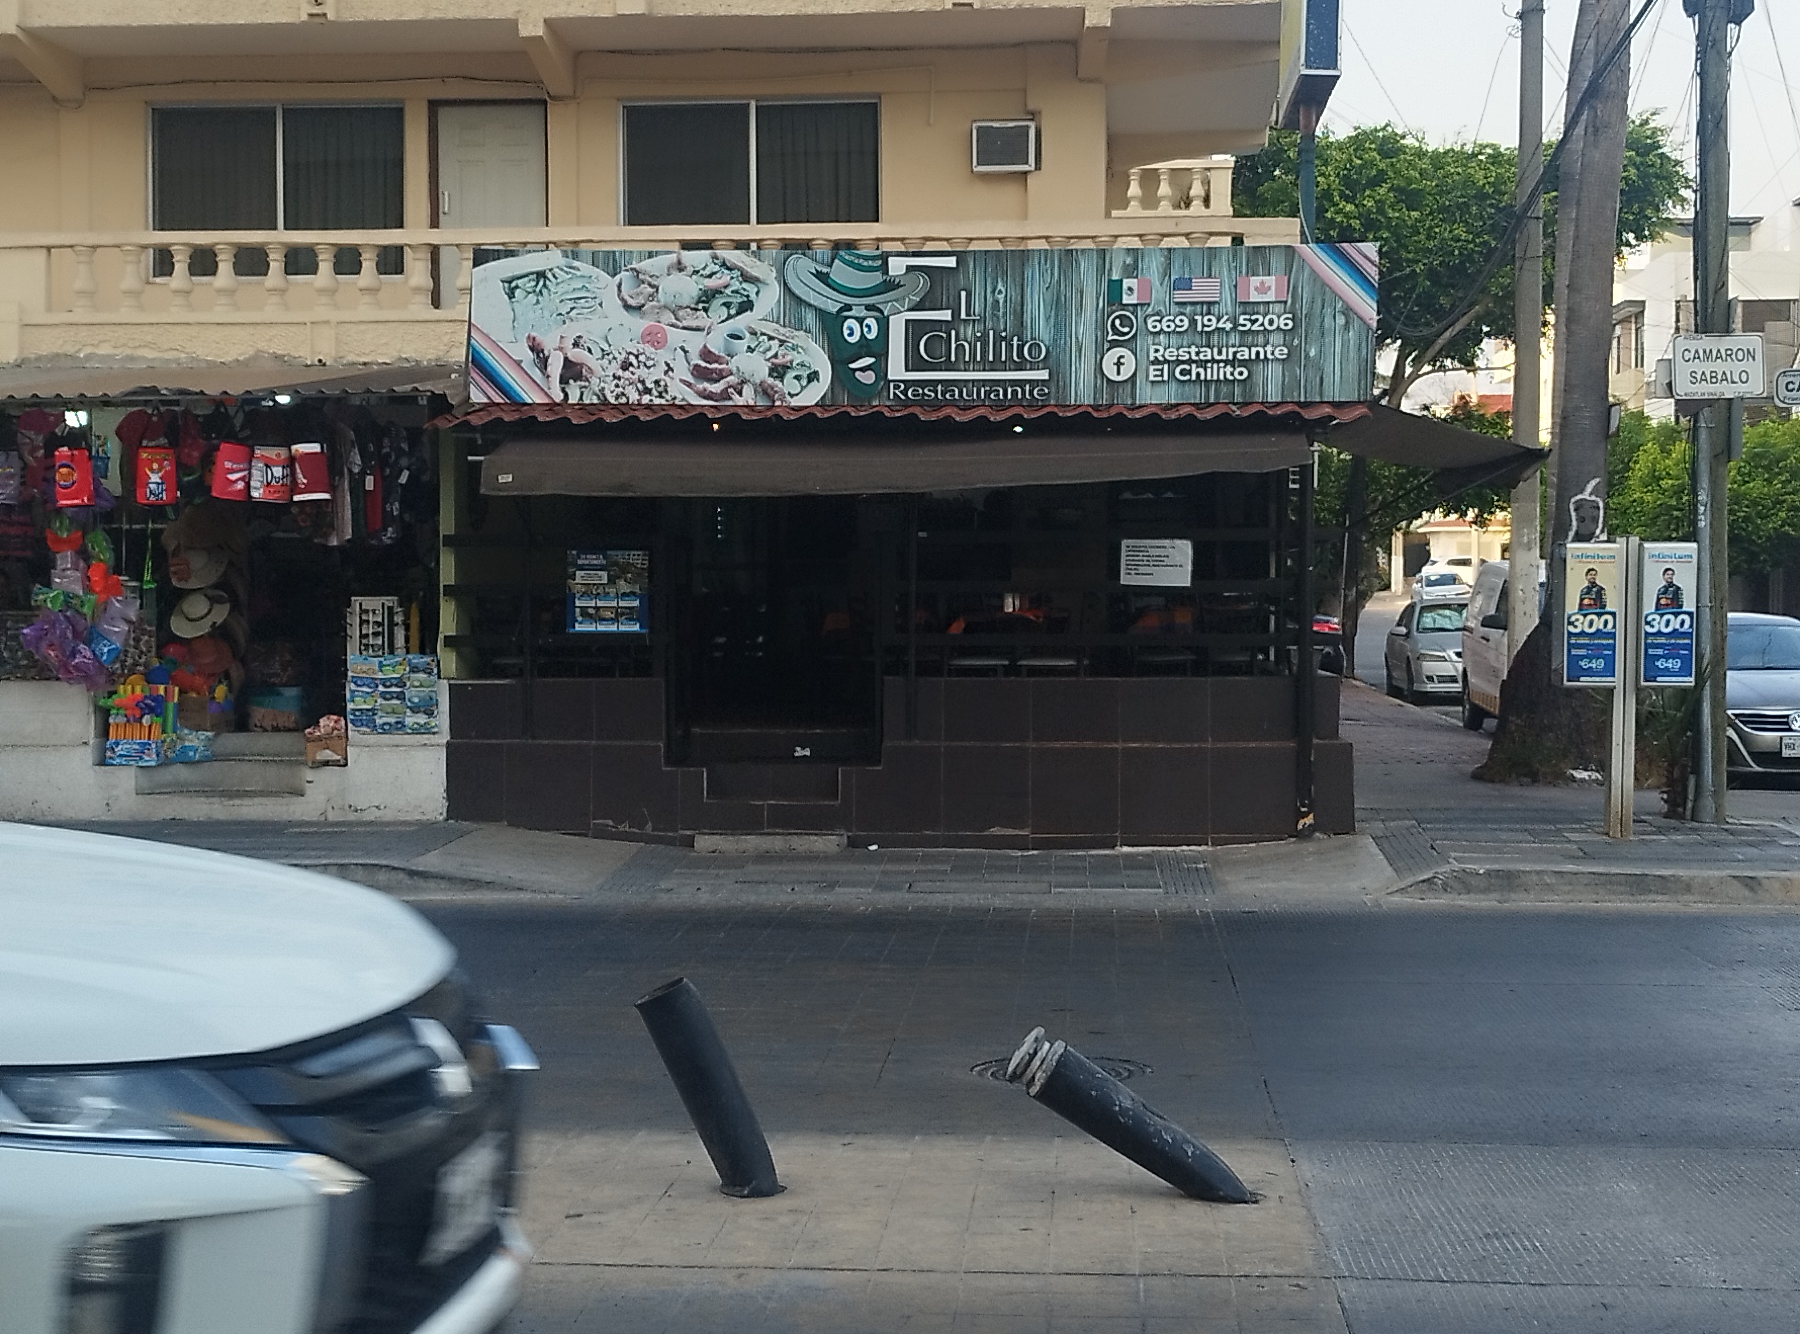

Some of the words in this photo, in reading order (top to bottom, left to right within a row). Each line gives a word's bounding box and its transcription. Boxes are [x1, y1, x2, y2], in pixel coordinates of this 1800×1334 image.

[1147, 315, 1189, 332] 669
[1195, 315, 1233, 332] 194
[1237, 313, 1294, 331] 5206
[919, 329, 1047, 363] Chilito
[1149, 345, 1289, 361] Restaurante
[1681, 347, 1756, 363] CAMARON
[1148, 364, 1168, 381] El
[1174, 363, 1249, 381] Chilito
[1689, 369, 1750, 385] SABALO
[888, 382, 1050, 400] Restaurante
[1567, 613, 1614, 634] 300
[1644, 613, 1691, 634] 300
